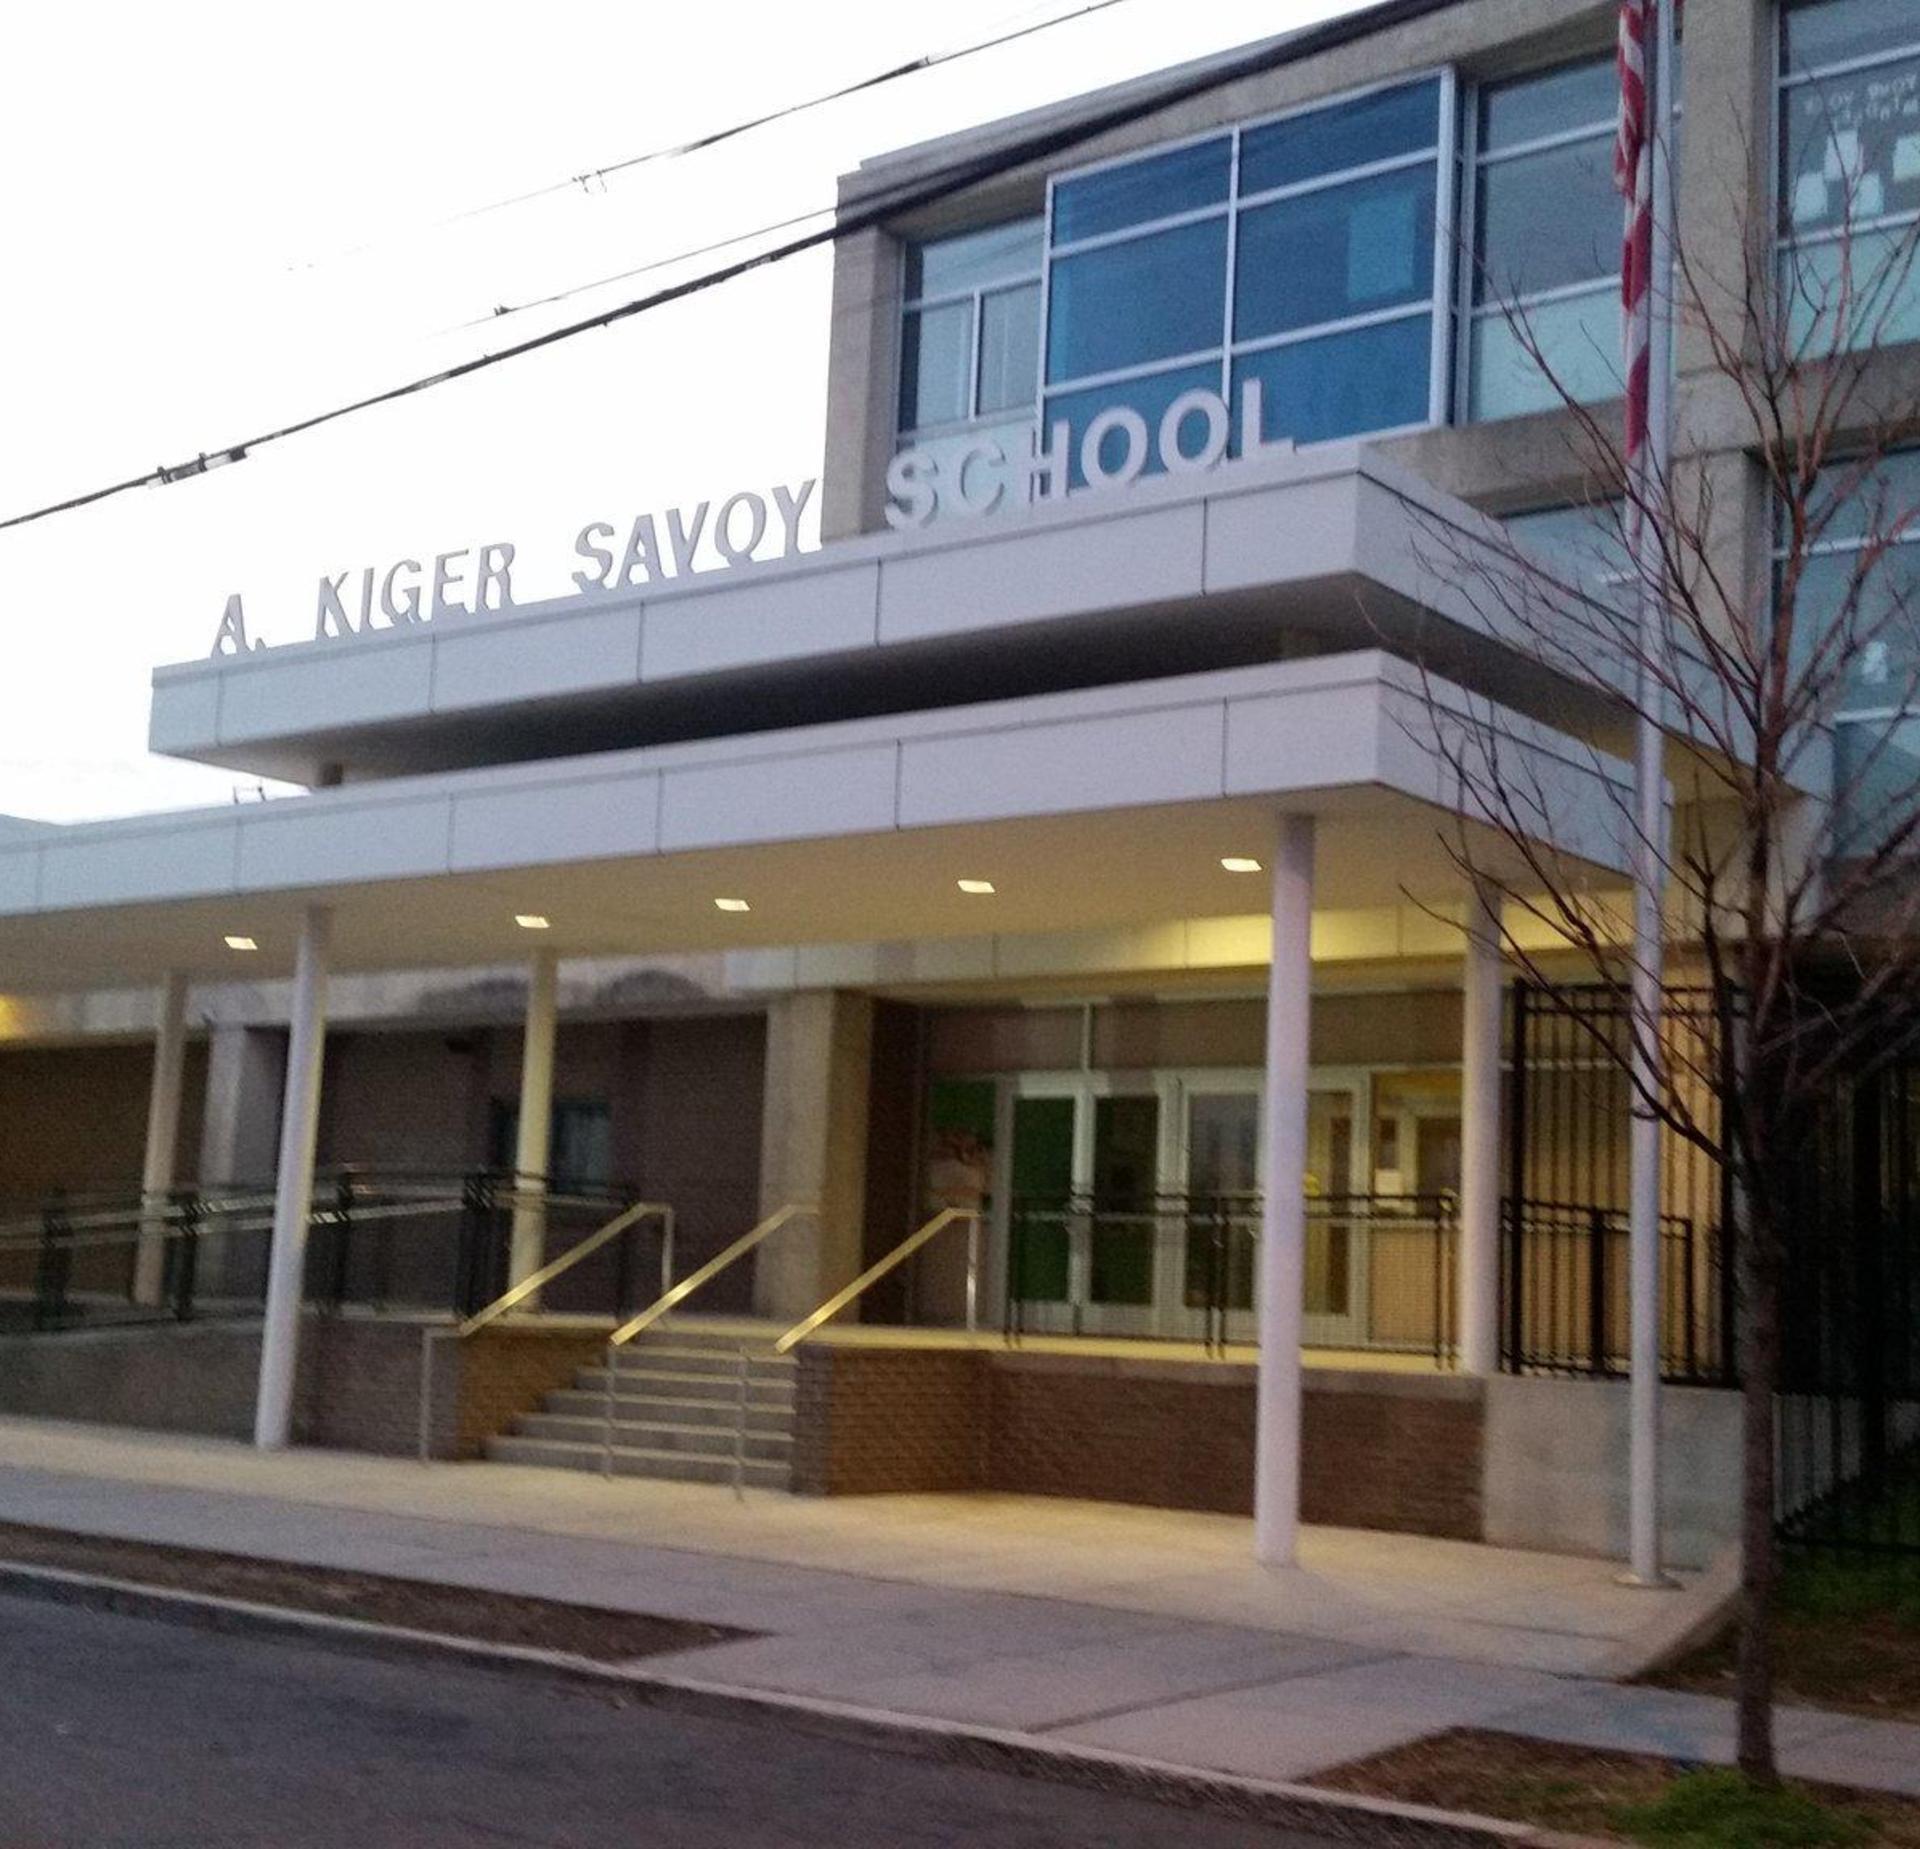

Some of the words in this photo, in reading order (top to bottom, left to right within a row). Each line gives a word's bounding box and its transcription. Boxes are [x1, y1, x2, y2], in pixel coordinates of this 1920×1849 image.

[210, 594, 268, 657] A.
[315, 543, 516, 642] KIGER
[572, 479, 817, 593] SAVOY
[884, 378, 1295, 531] SCHOOL
